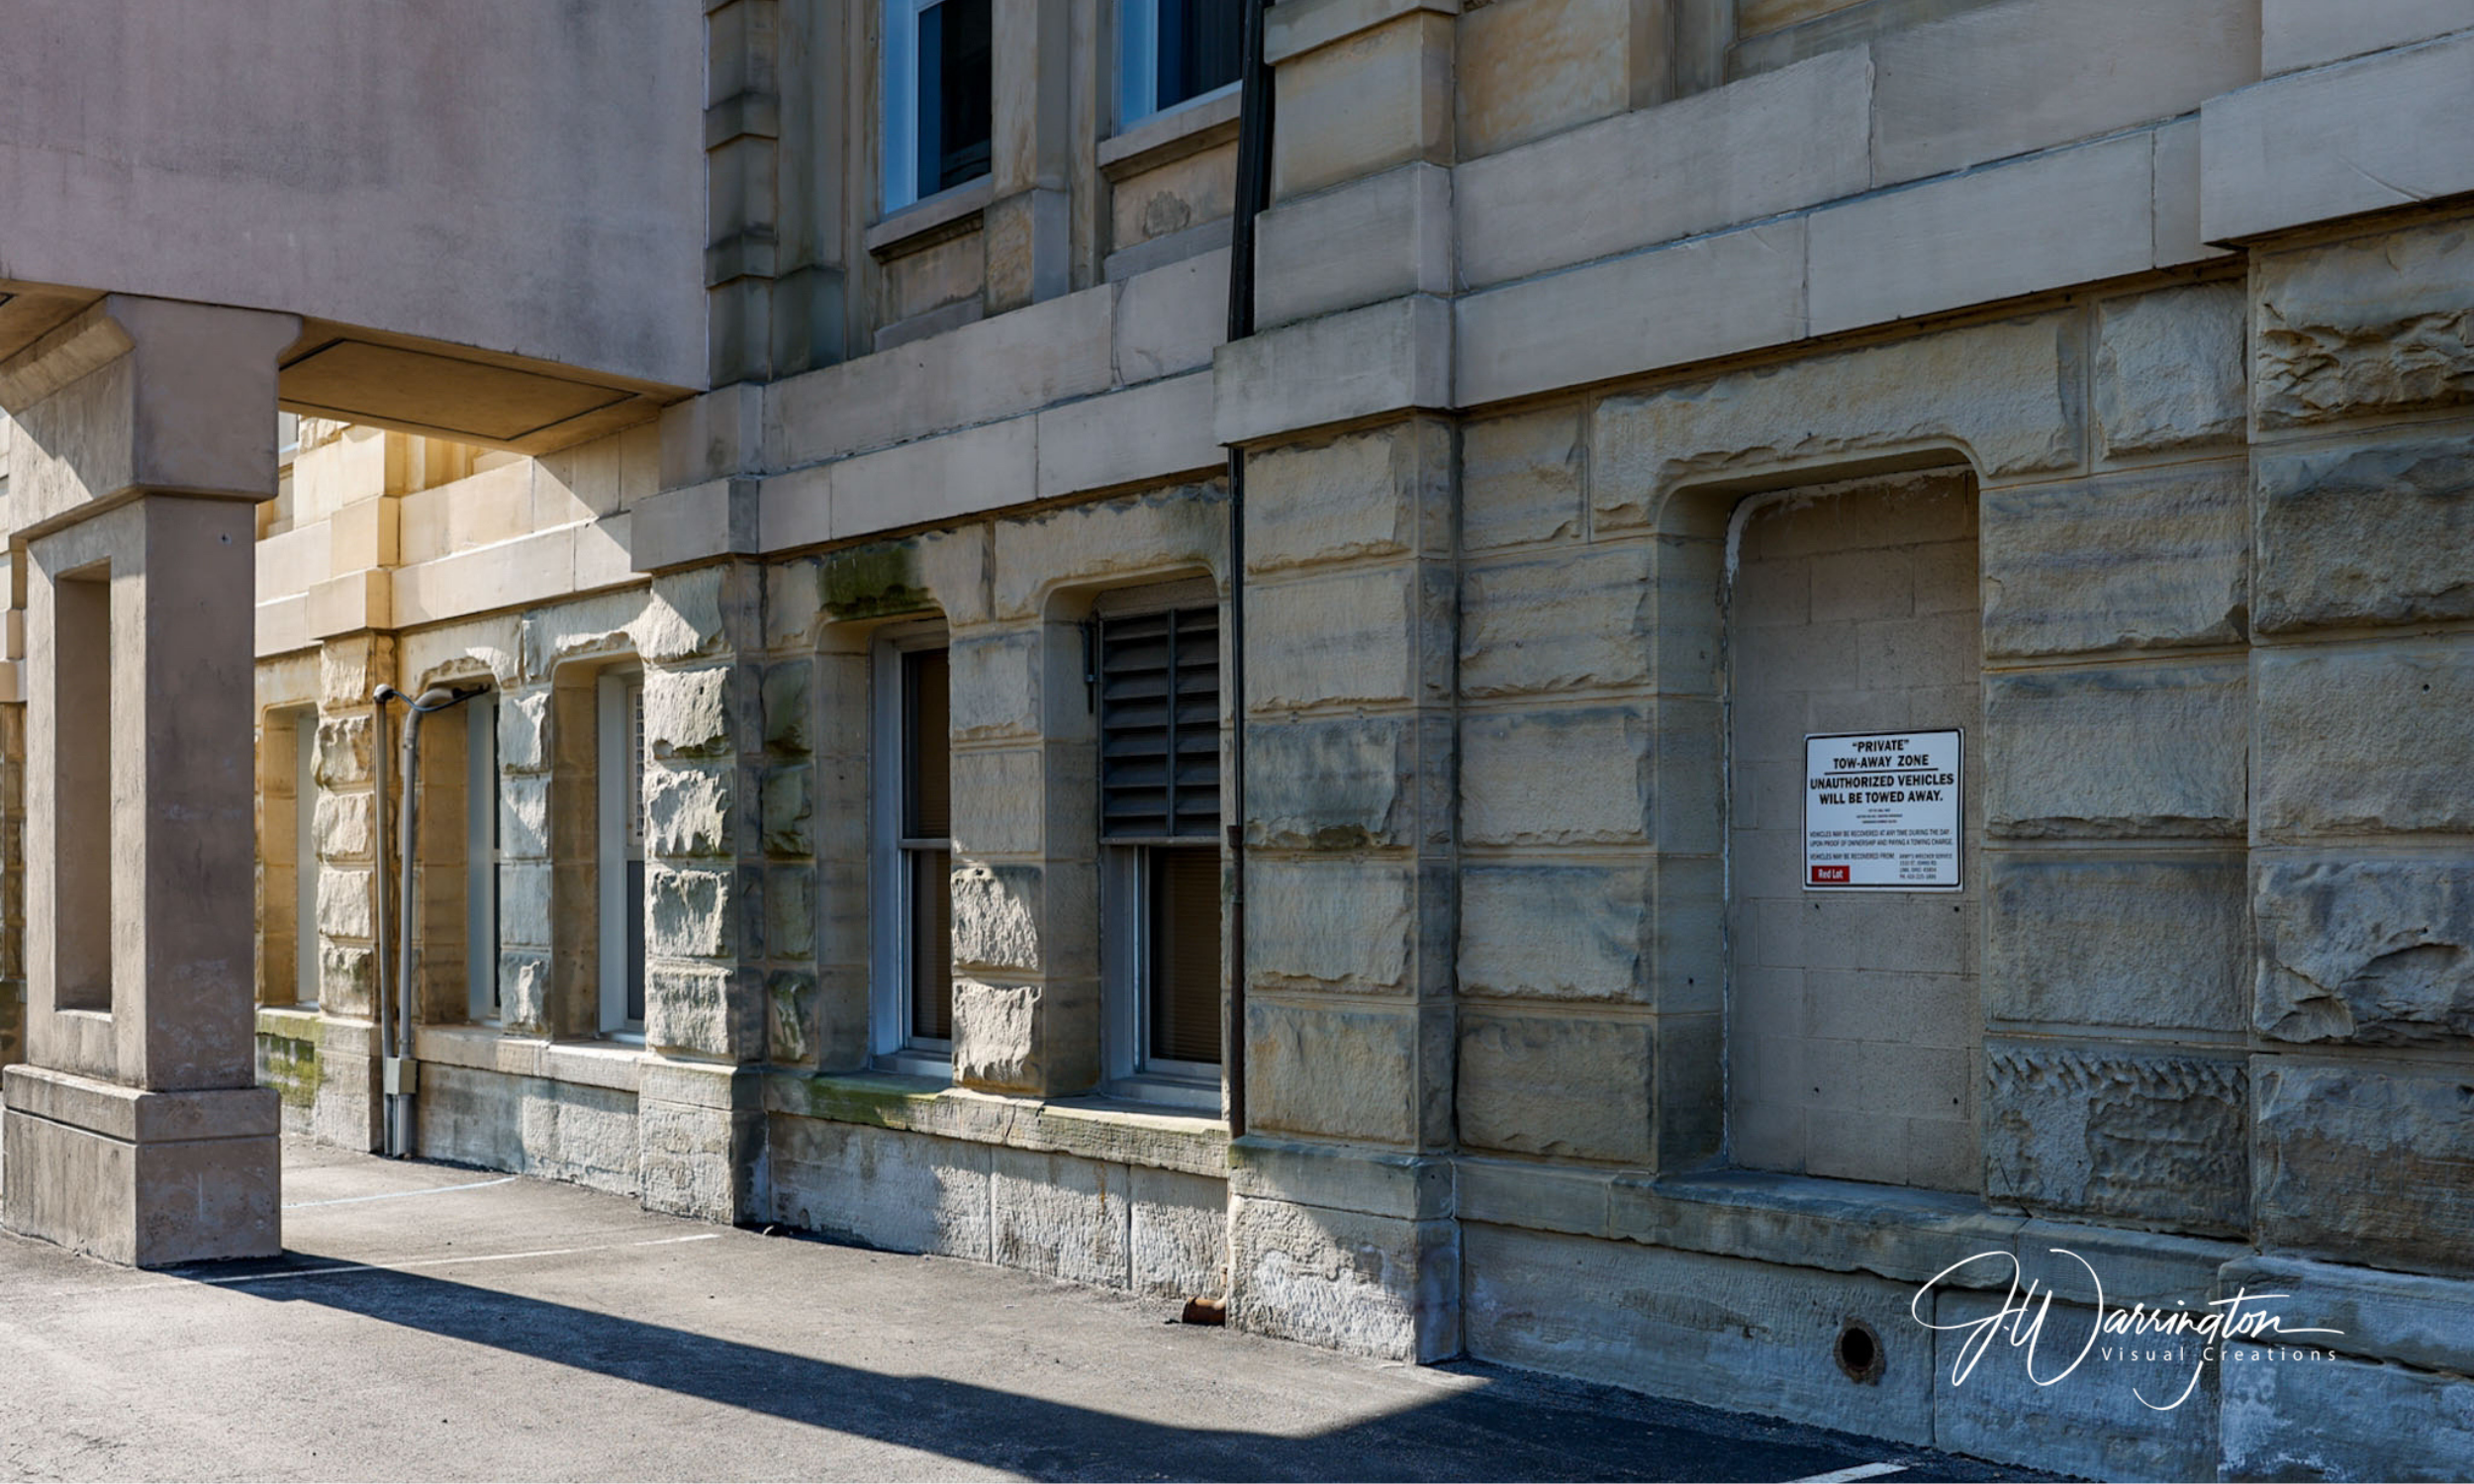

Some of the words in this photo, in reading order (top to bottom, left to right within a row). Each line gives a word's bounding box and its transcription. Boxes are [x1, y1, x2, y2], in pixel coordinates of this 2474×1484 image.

[1834, 755, 1892, 769] TOW-AWAY
[1898, 754, 1929, 766] ZONE
[1810, 776, 1894, 789] UNAUTHORIZED
[1898, 773, 1954, 787] VEHICLES
[1820, 792, 1845, 805] WILL
[1849, 792, 1862, 803] BE
[1865, 790, 1905, 803] TOWED
[1908, 789, 1944, 802] AWAY.
[1818, 869, 1831, 880] Red
[1832, 869, 1844, 880] Lot
